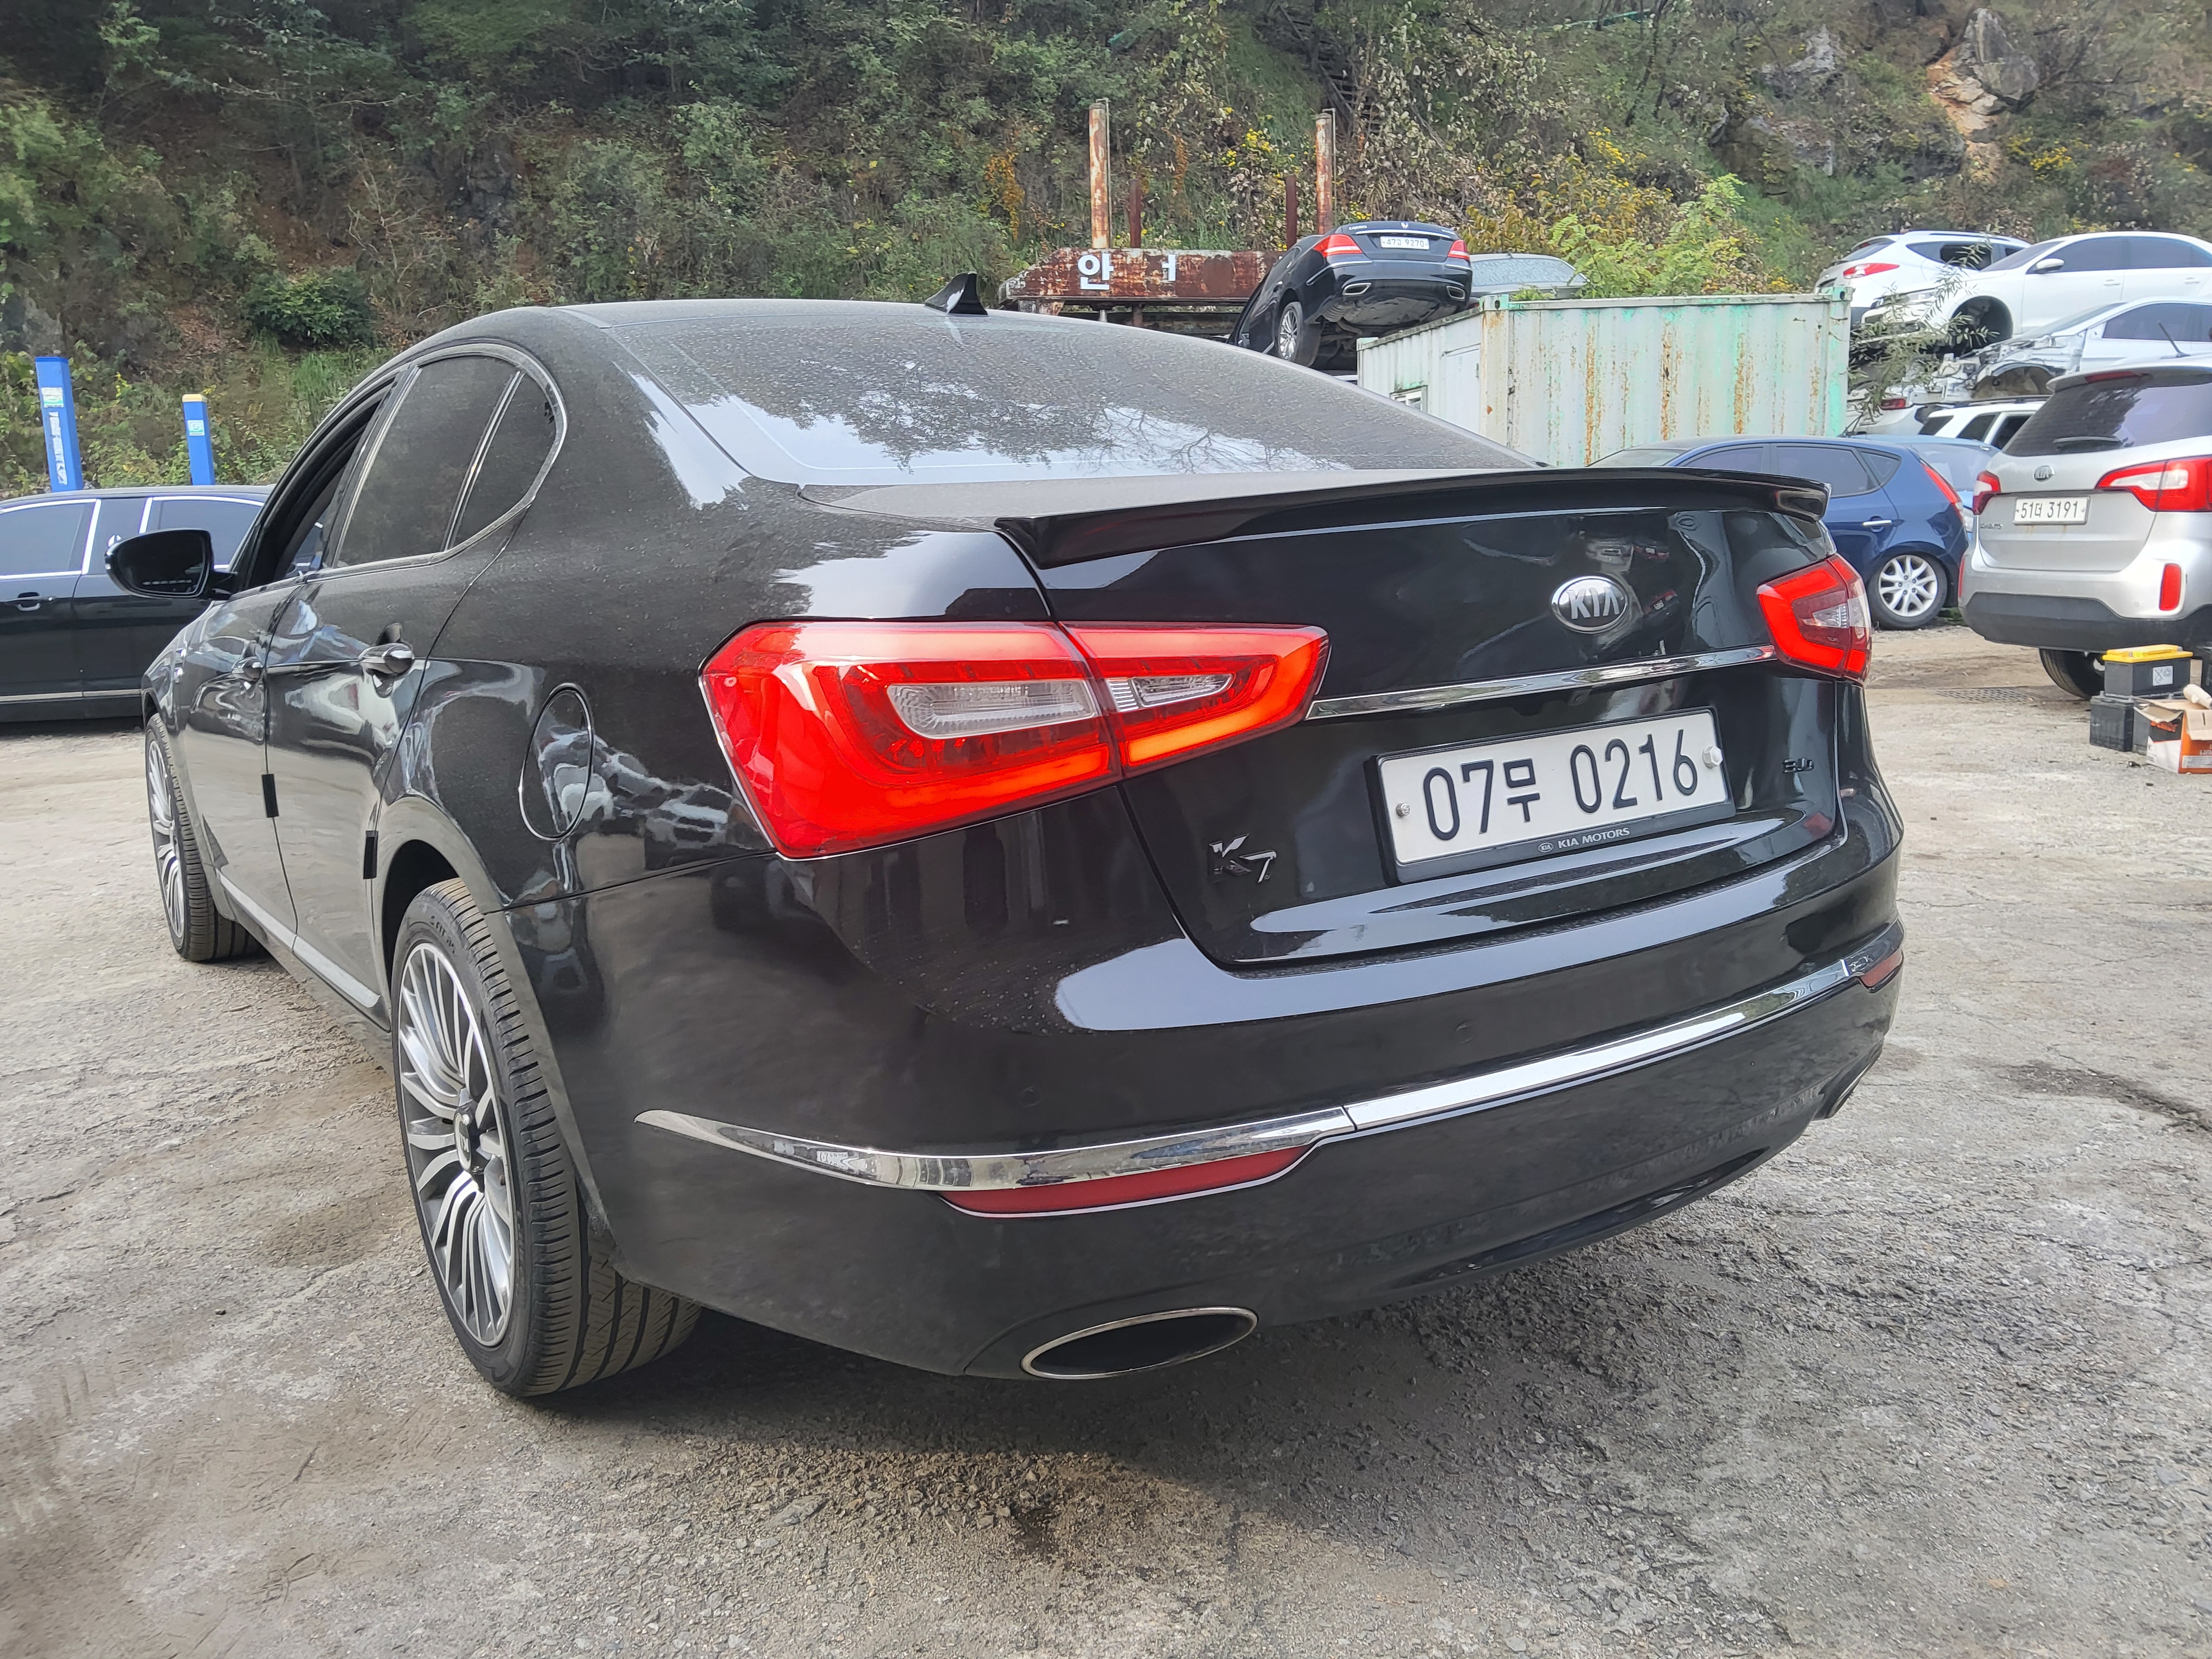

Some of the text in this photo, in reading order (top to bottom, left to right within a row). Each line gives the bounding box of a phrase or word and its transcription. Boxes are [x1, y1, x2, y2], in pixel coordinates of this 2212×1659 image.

[1405, 239, 1425, 247] 9270
[1077, 253, 1114, 290] 안
[2047, 500, 2078, 518] 3191
[1565, 586, 1621, 620] KIA
[1423, 729, 1698, 841] 07무 0216
[1558, 838, 1580, 849] KIA
[1582, 827, 1631, 845] MOTORS
[1207, 833, 1277, 884] K7
